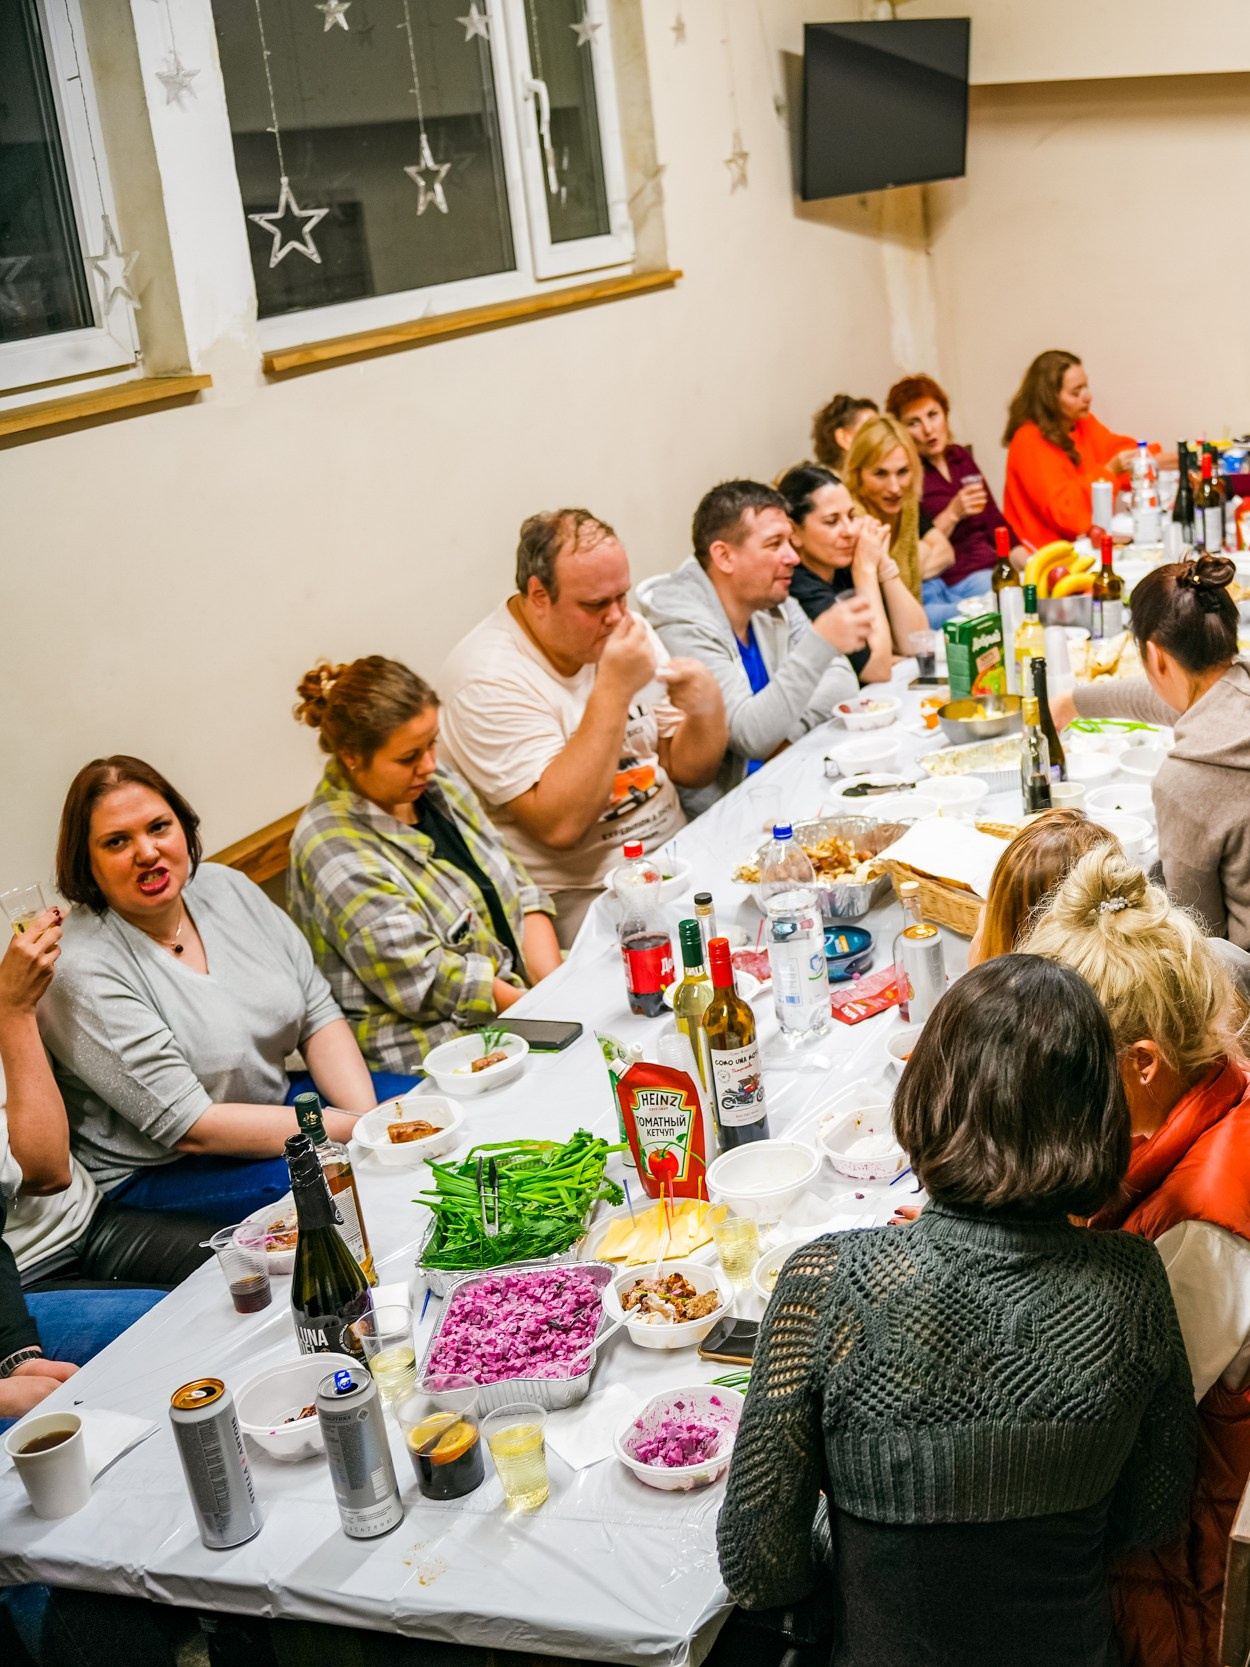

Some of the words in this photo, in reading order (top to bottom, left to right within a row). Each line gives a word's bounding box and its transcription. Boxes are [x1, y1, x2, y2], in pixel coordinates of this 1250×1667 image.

[641, 1093, 679, 1107] HEINZ
[635, 1114, 687, 1127] ТОМАТНЫЙ
[646, 1128, 675, 1137] КЕТЧУП
[295, 1323, 329, 1347] LUNA
[231, 1417, 244, 1455] ARTOIS
[243, 1466, 255, 1505] STELLA
